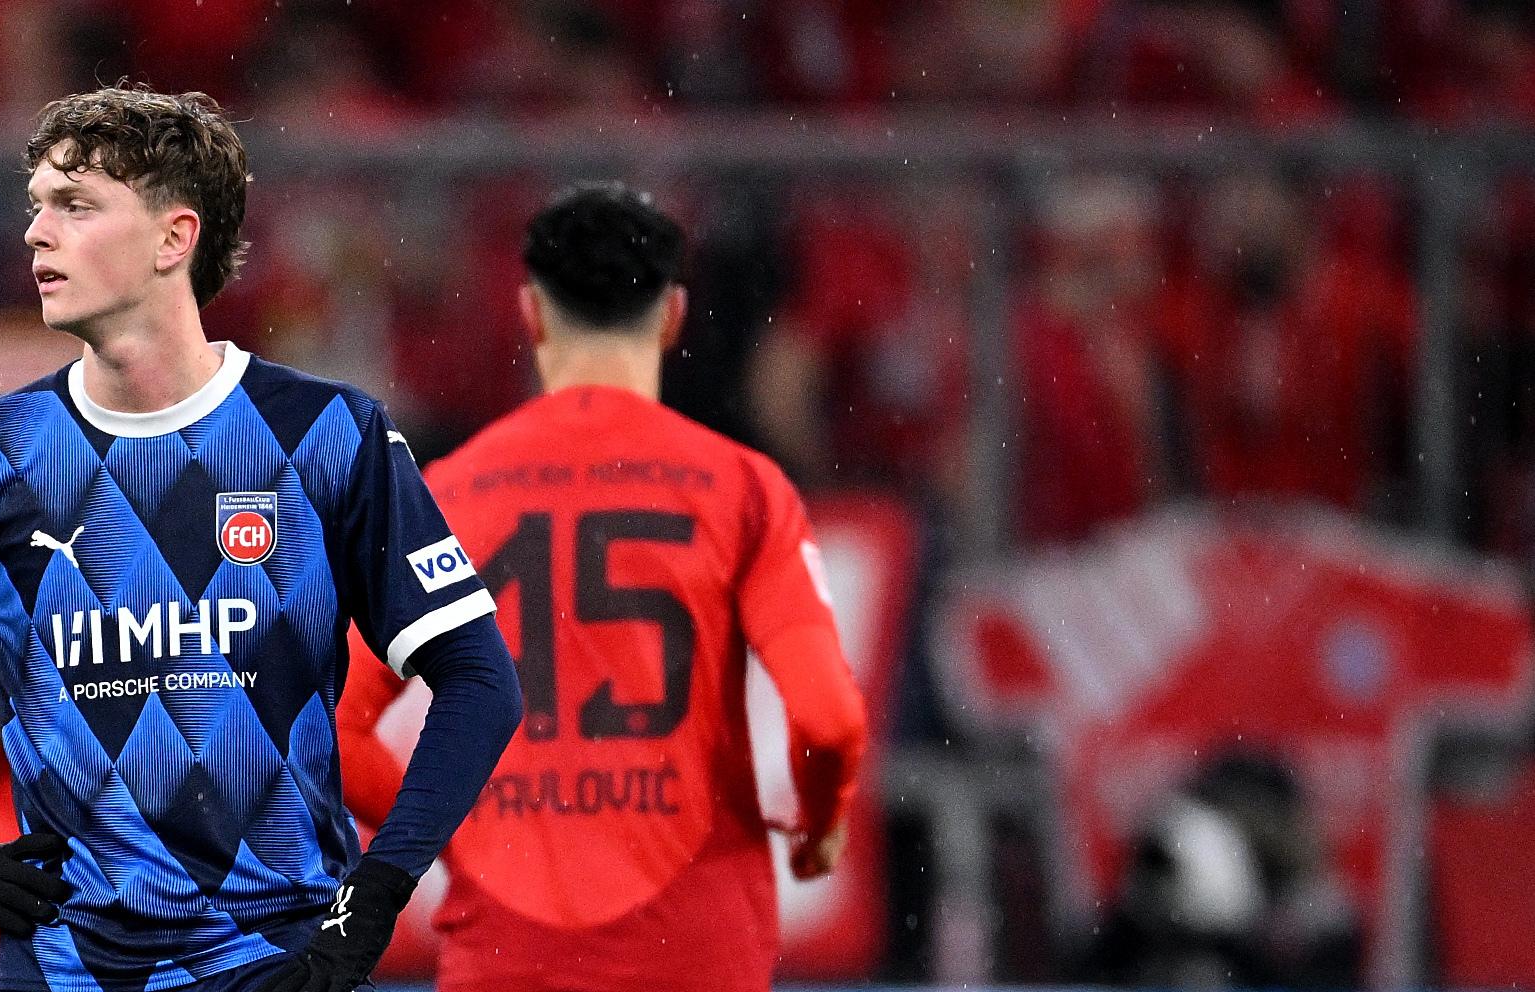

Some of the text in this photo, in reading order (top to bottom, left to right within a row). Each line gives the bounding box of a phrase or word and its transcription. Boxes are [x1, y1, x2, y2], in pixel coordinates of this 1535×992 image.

[228, 526, 266, 548] FCH
[117, 598, 257, 663] MHP
[478, 508, 698, 742] 15
[58, 671, 258, 703] A PORSCHE COMPANY
